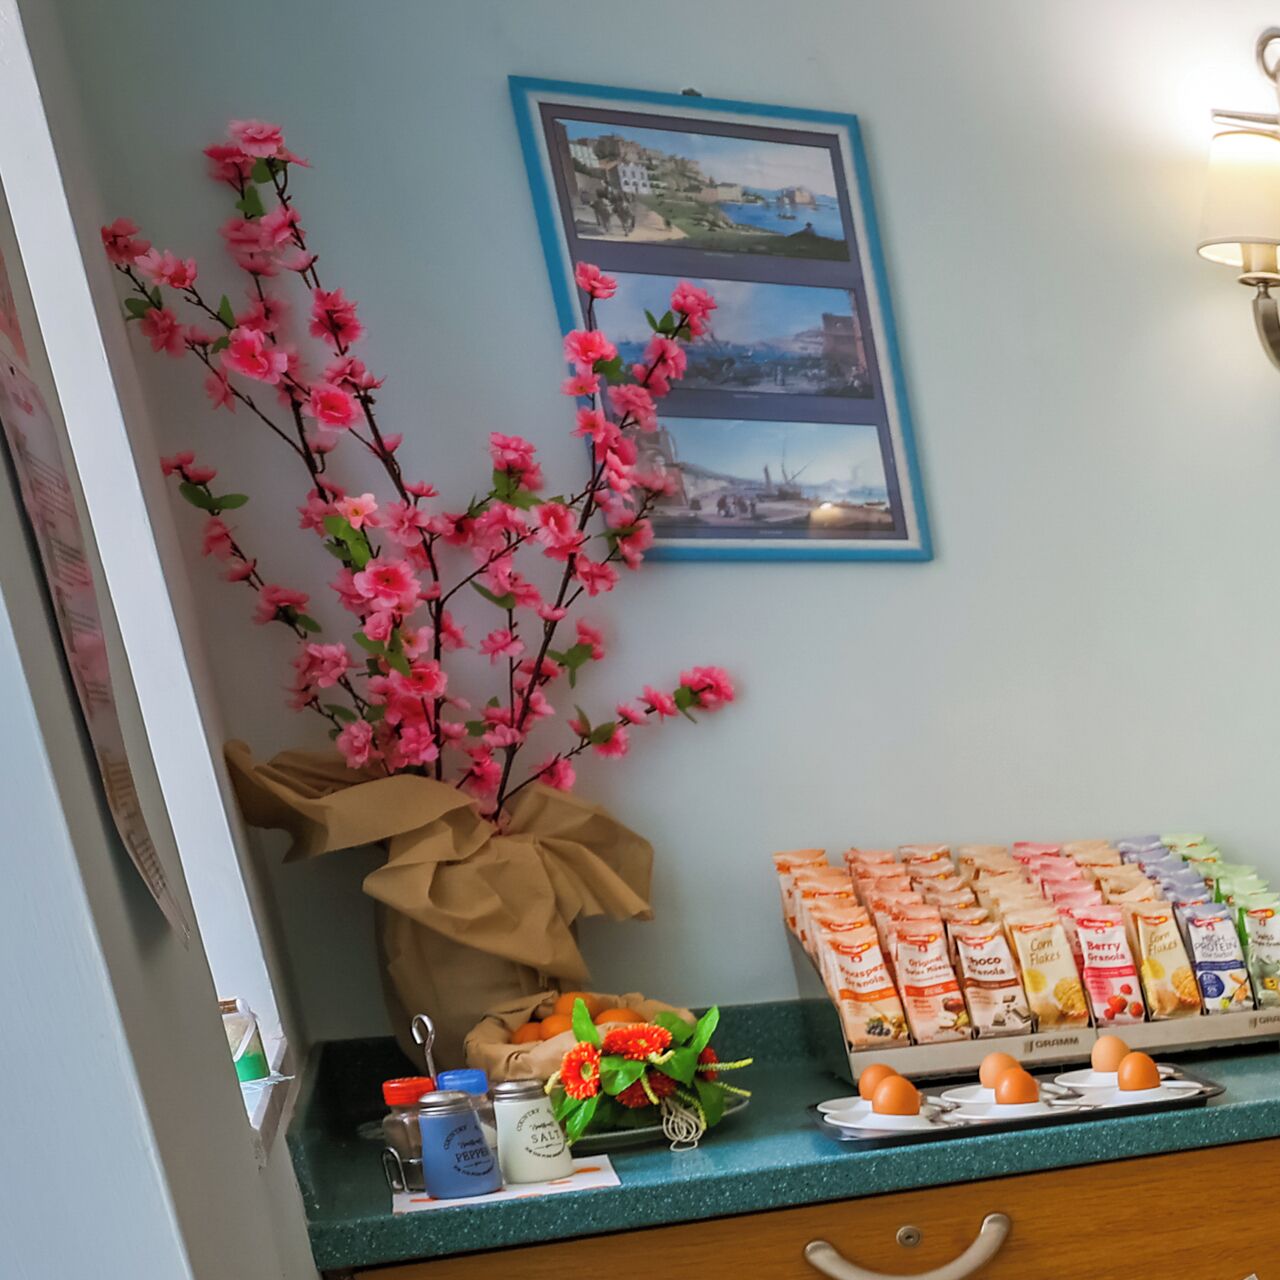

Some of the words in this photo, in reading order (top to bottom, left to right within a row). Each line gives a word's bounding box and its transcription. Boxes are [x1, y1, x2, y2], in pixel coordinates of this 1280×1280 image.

[1149, 931, 1170, 943] Corn
[1030, 937, 1053, 952] Corn
[1086, 940, 1121, 954] Berry
[1030, 950, 1061, 966] Flakes
[1087, 953, 1126, 962] Granola
[1035, 1036, 1080, 1048] GRAMM
[530, 1129, 560, 1144] SALT
